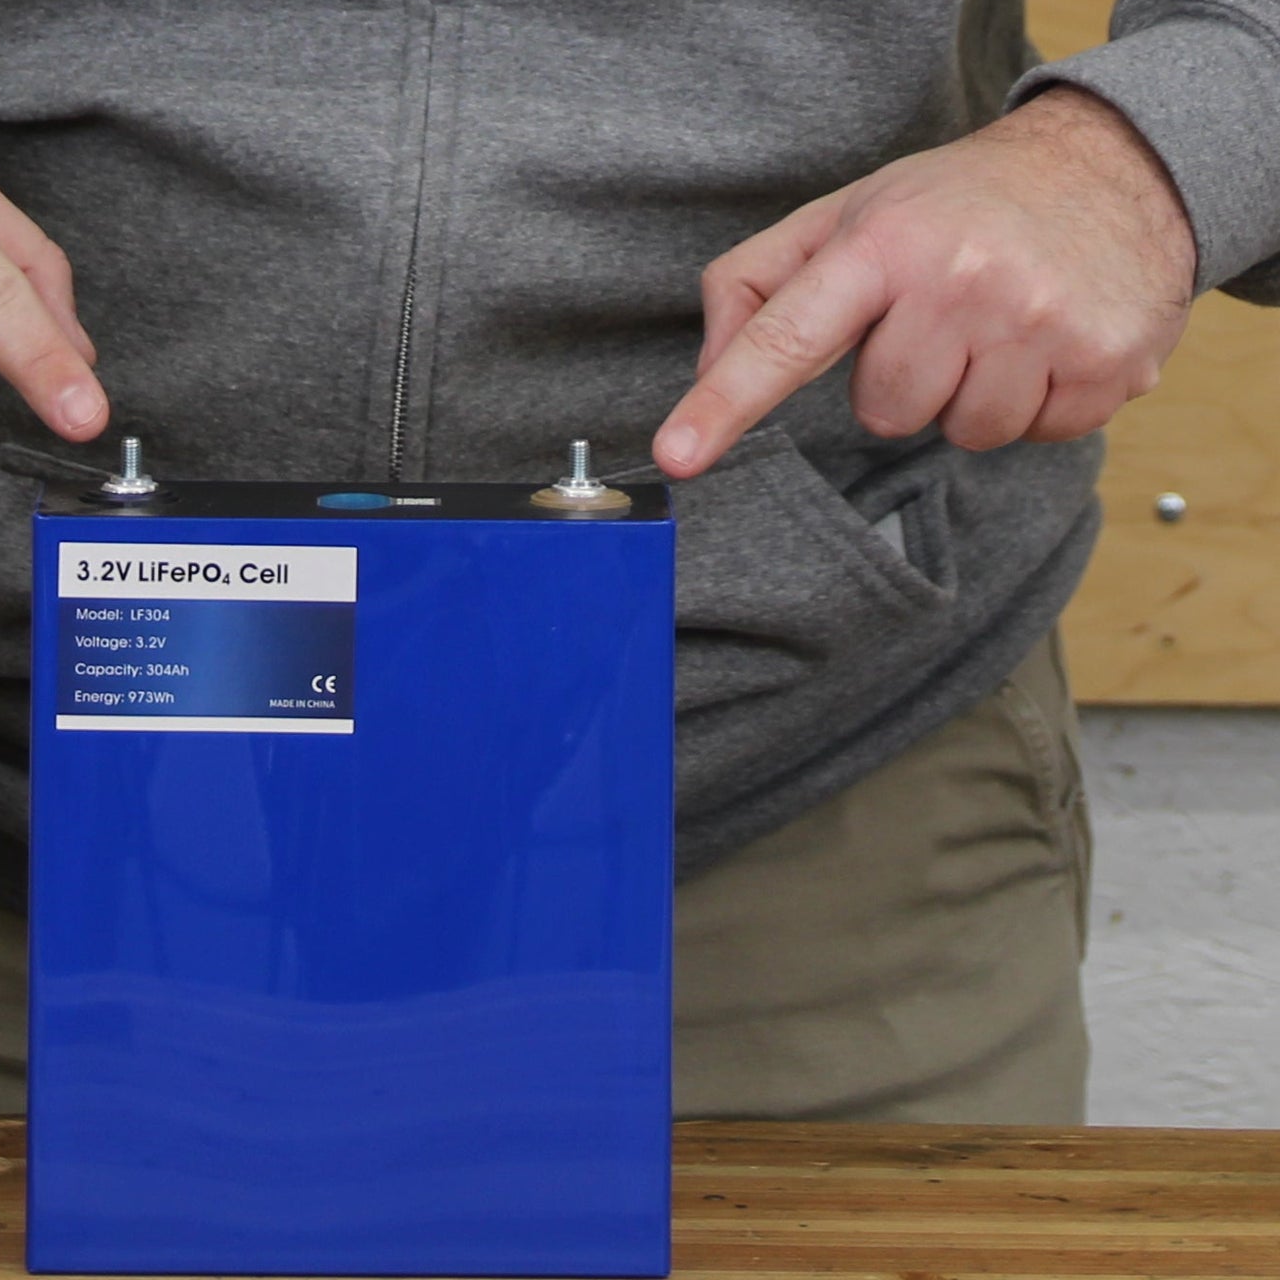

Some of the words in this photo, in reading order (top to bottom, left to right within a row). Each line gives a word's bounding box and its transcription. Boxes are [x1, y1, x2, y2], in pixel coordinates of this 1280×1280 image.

[77, 560, 132, 582] 3.2V
[239, 563, 289, 584] Cell
[76, 608, 124, 621] Model:
[130, 609, 170, 621] LF304
[75, 635, 133, 651] Voltage:
[135, 636, 166, 649] 3.2V
[74, 662, 143, 677] Capacity:
[146, 664, 190, 677] 304Ah
[74, 690, 125, 706] Energy:
[128, 691, 175, 704] 973Wh
[269, 698, 295, 708] MADE
[296, 699, 306, 708] IN
[307, 699, 336, 708] CHINA
